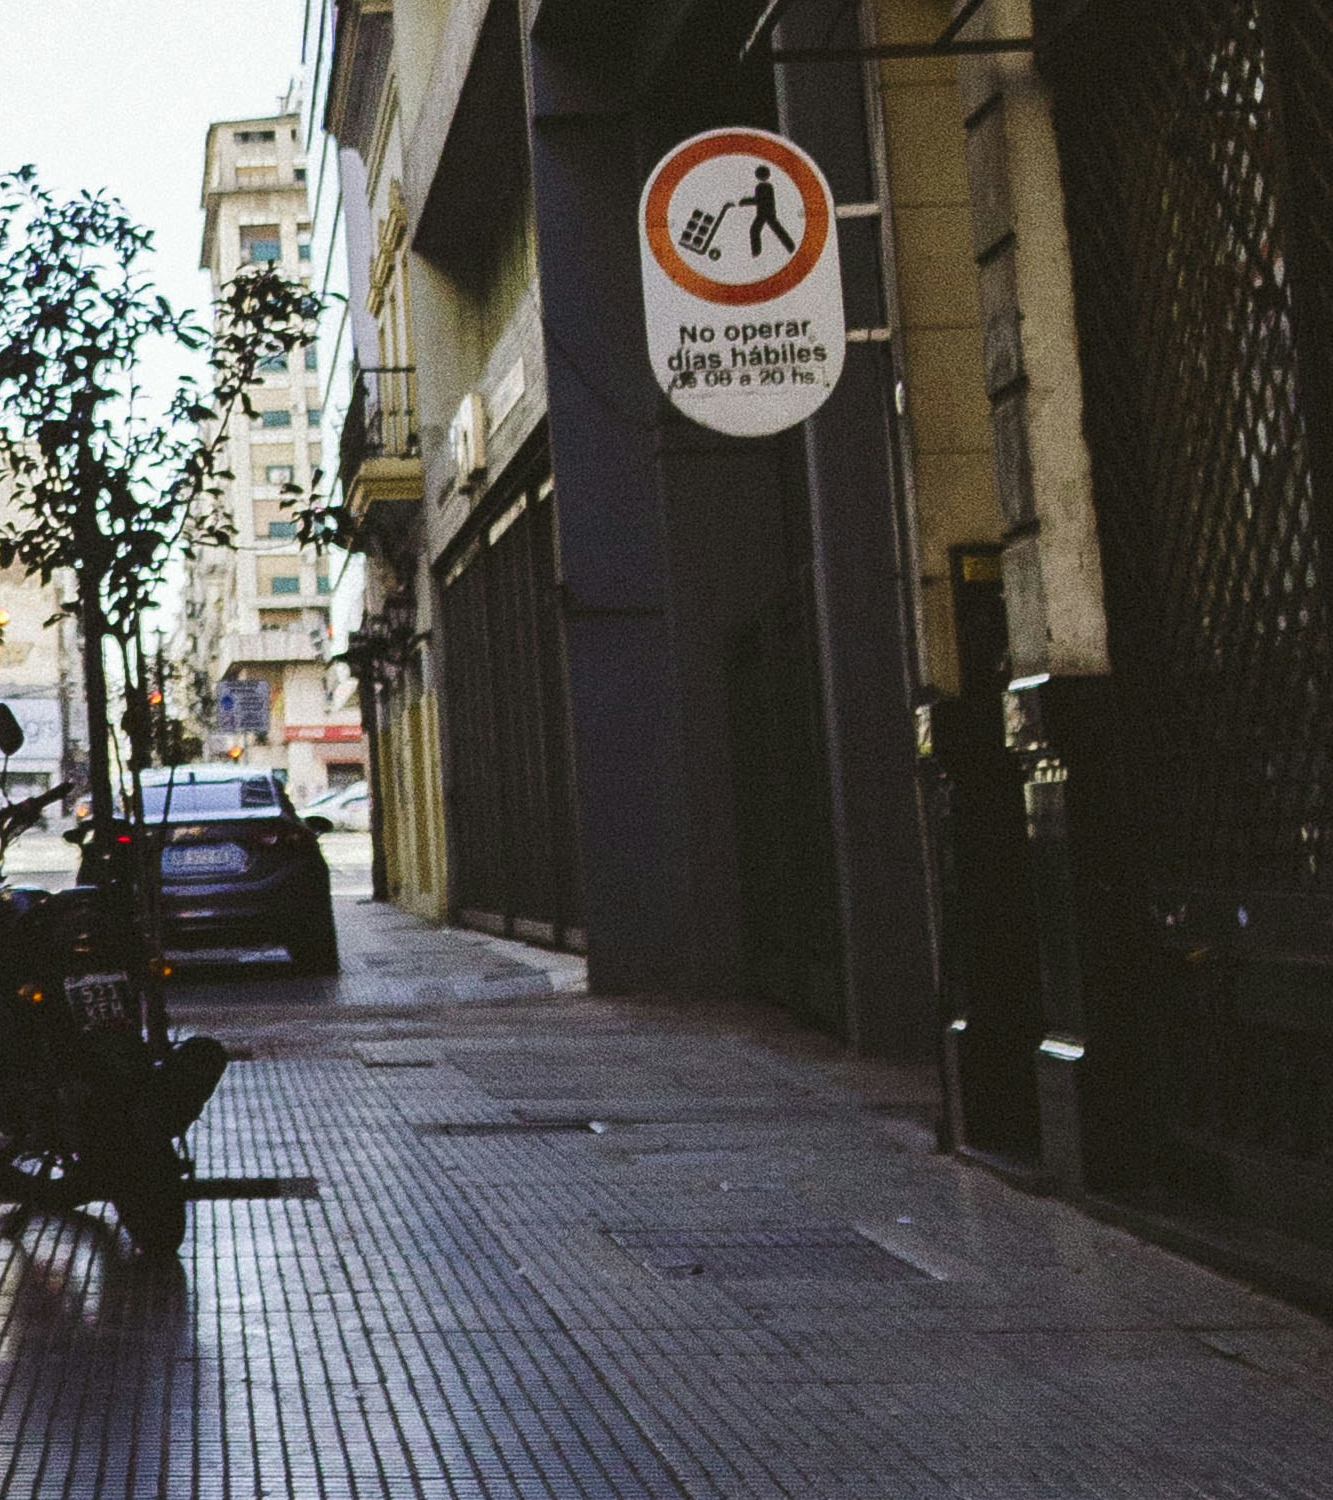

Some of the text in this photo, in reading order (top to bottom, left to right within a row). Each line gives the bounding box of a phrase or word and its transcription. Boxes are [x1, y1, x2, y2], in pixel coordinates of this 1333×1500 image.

[679, 319, 811, 345] No operar
[667, 343, 828, 372] días hábiles
[739, 373, 752, 387] a
[758, 367, 785, 386] 20
